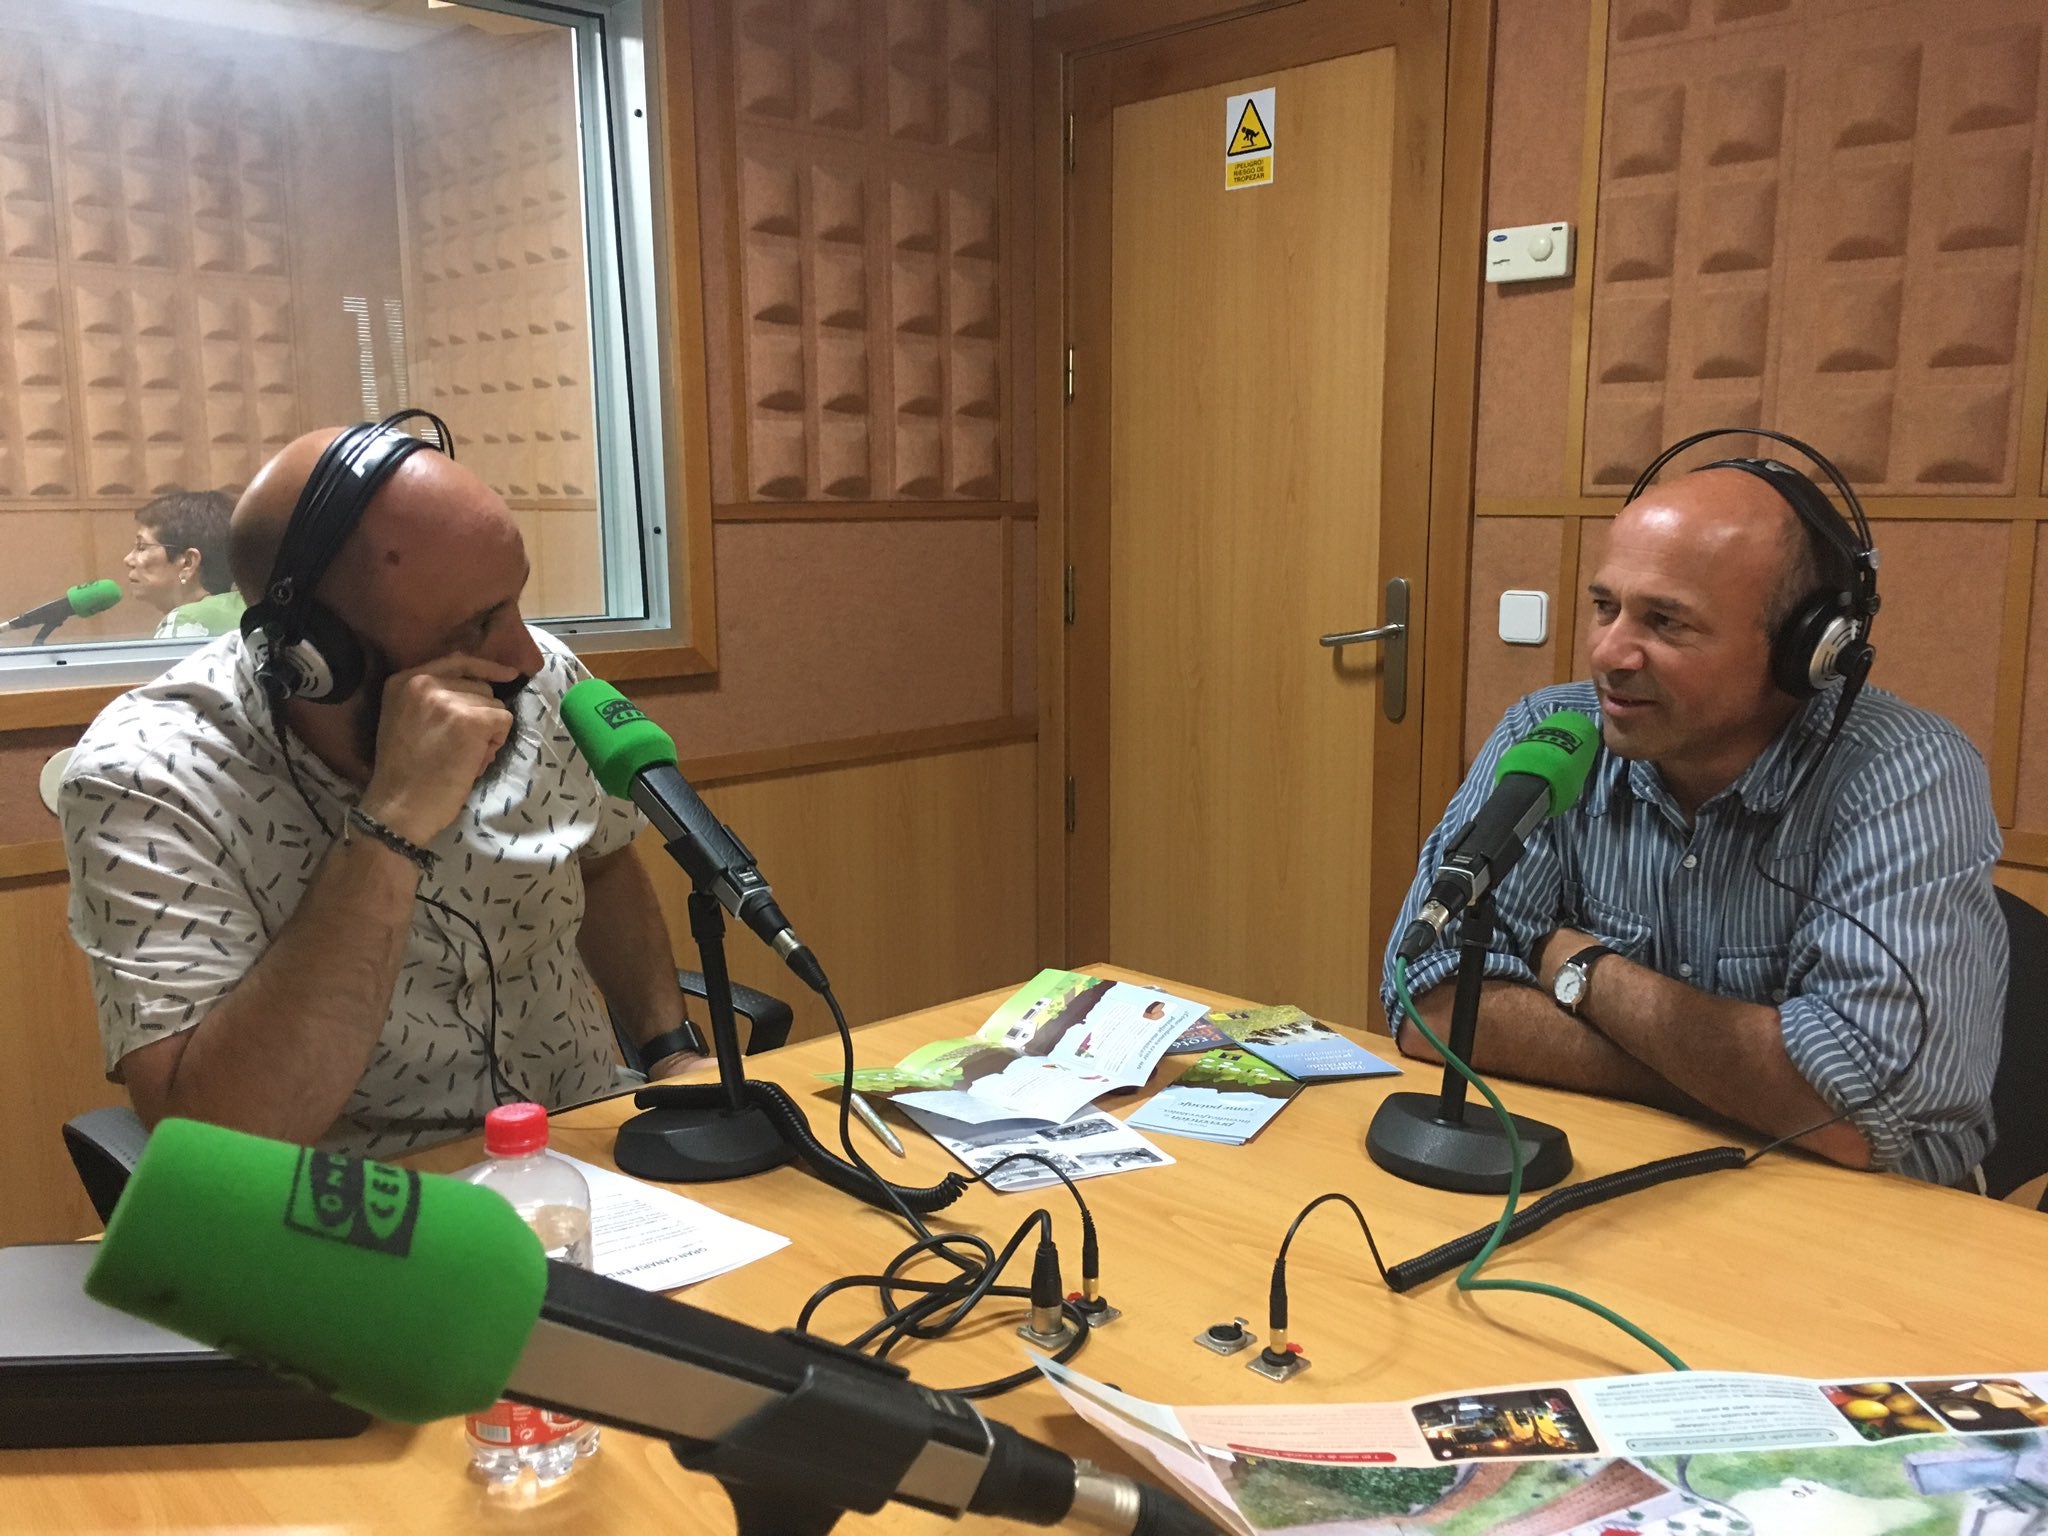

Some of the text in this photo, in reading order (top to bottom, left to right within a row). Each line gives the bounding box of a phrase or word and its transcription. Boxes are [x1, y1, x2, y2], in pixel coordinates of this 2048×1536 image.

[1234, 166, 1256, 176] RIESGO
[1234, 172, 1265, 183] TROPEZAR
[632, 1256, 677, 1272] CANARIA
[616, 1268, 632, 1276] EN
